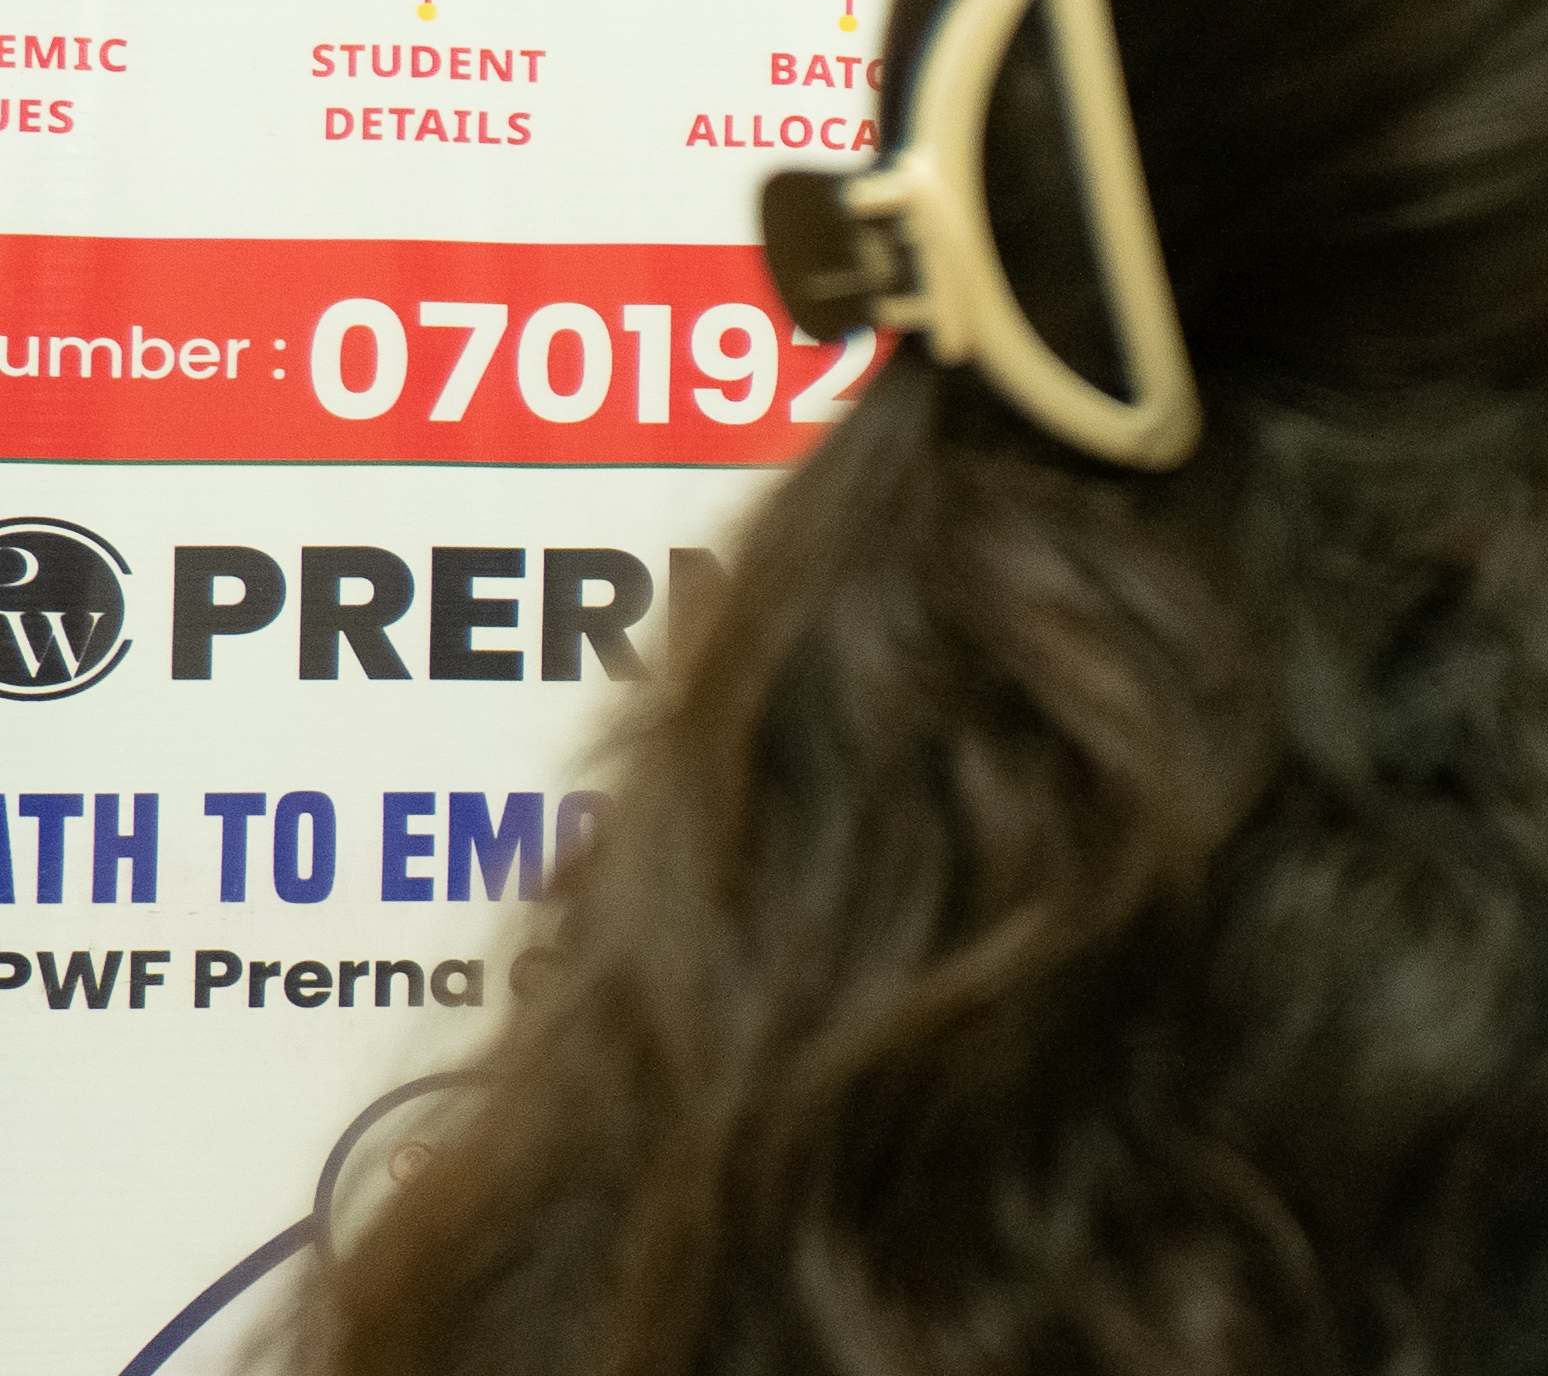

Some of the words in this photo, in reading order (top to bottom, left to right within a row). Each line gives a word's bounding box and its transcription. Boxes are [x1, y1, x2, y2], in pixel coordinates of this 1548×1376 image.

[0, 35, 128, 72] EMIC
[312, 44, 546, 82] STUDENT
[325, 107, 532, 145] DETAILS
[686, 114, 880, 151] ALLOCA
[0, 326, 250, 380] umber
[311, 297, 877, 424] 070192
[204, 790, 337, 904] TO
[194, 950, 485, 1009] Prerna
